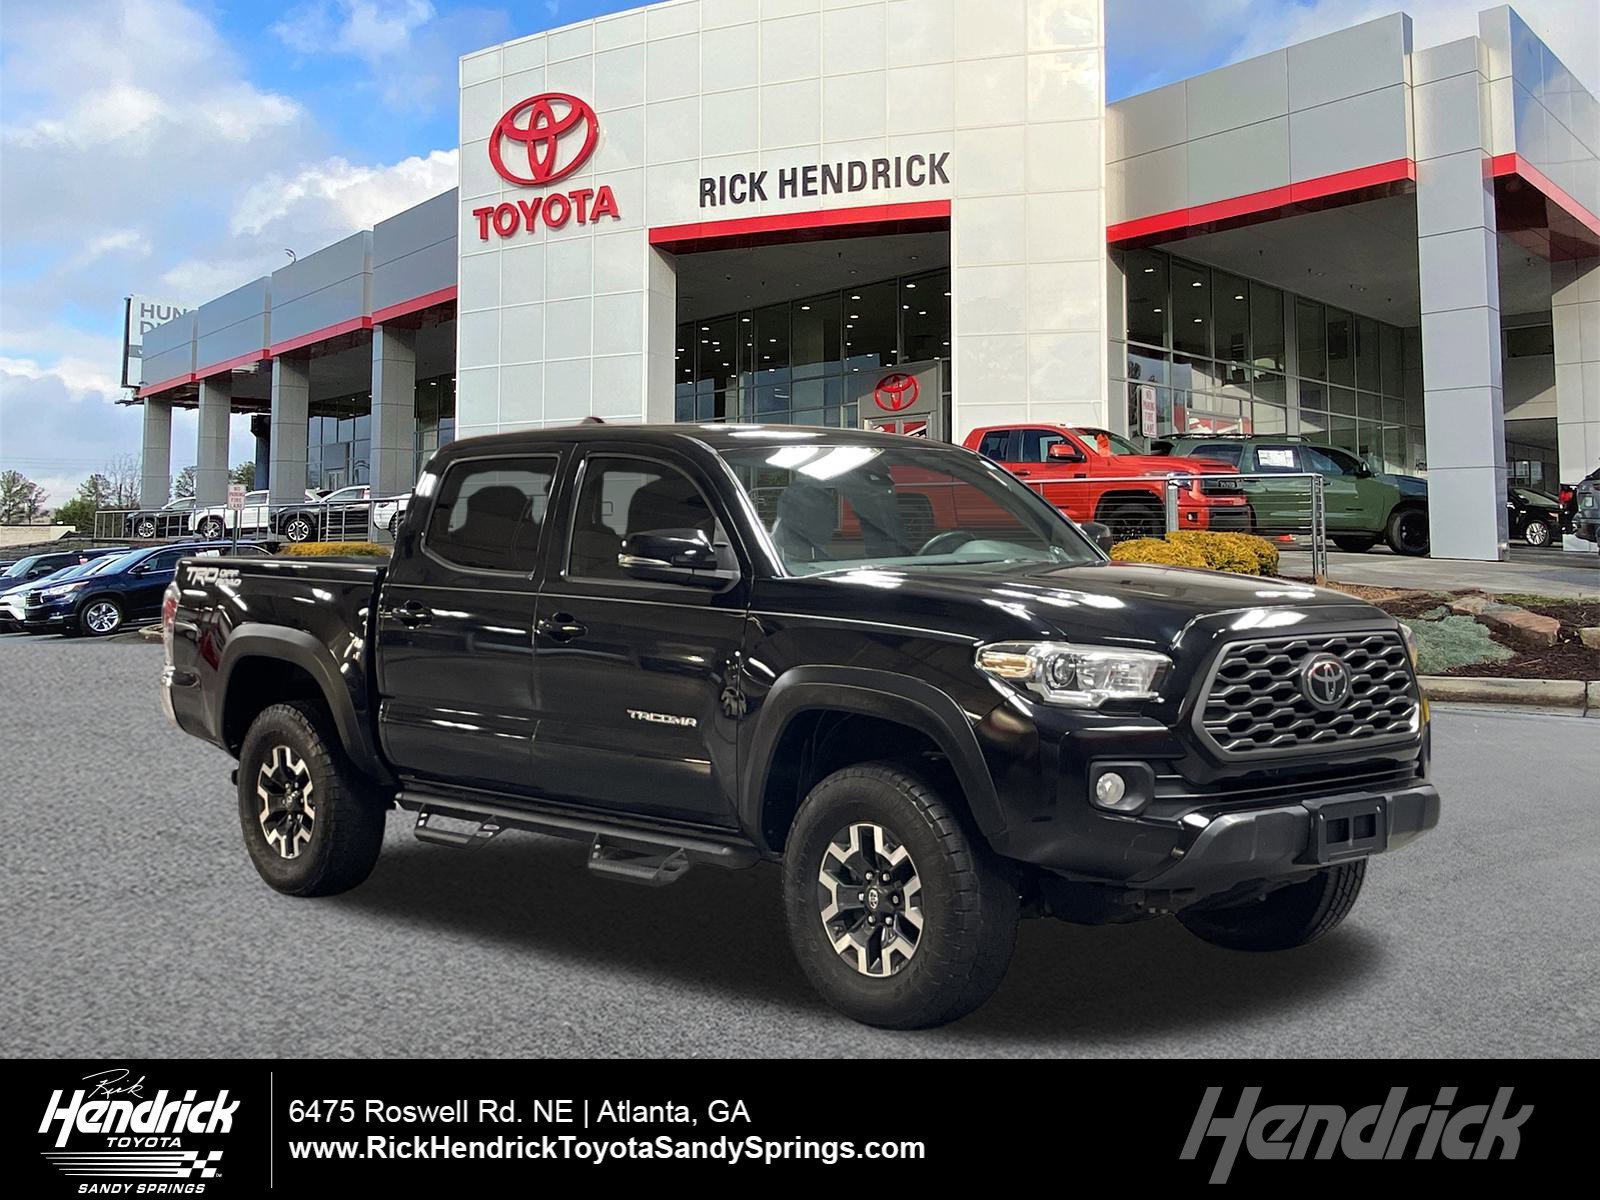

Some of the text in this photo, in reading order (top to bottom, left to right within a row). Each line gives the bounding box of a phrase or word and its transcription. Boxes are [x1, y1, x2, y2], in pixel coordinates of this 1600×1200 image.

[699, 152, 952, 208] RICK HENDRICK
[472, 185, 621, 241] TOYOTA
[186, 566, 219, 587] TRD
[215, 577, 242, 587] ROAD
[219, 568, 240, 577] OFF
[626, 709, 698, 728] TACOMA
